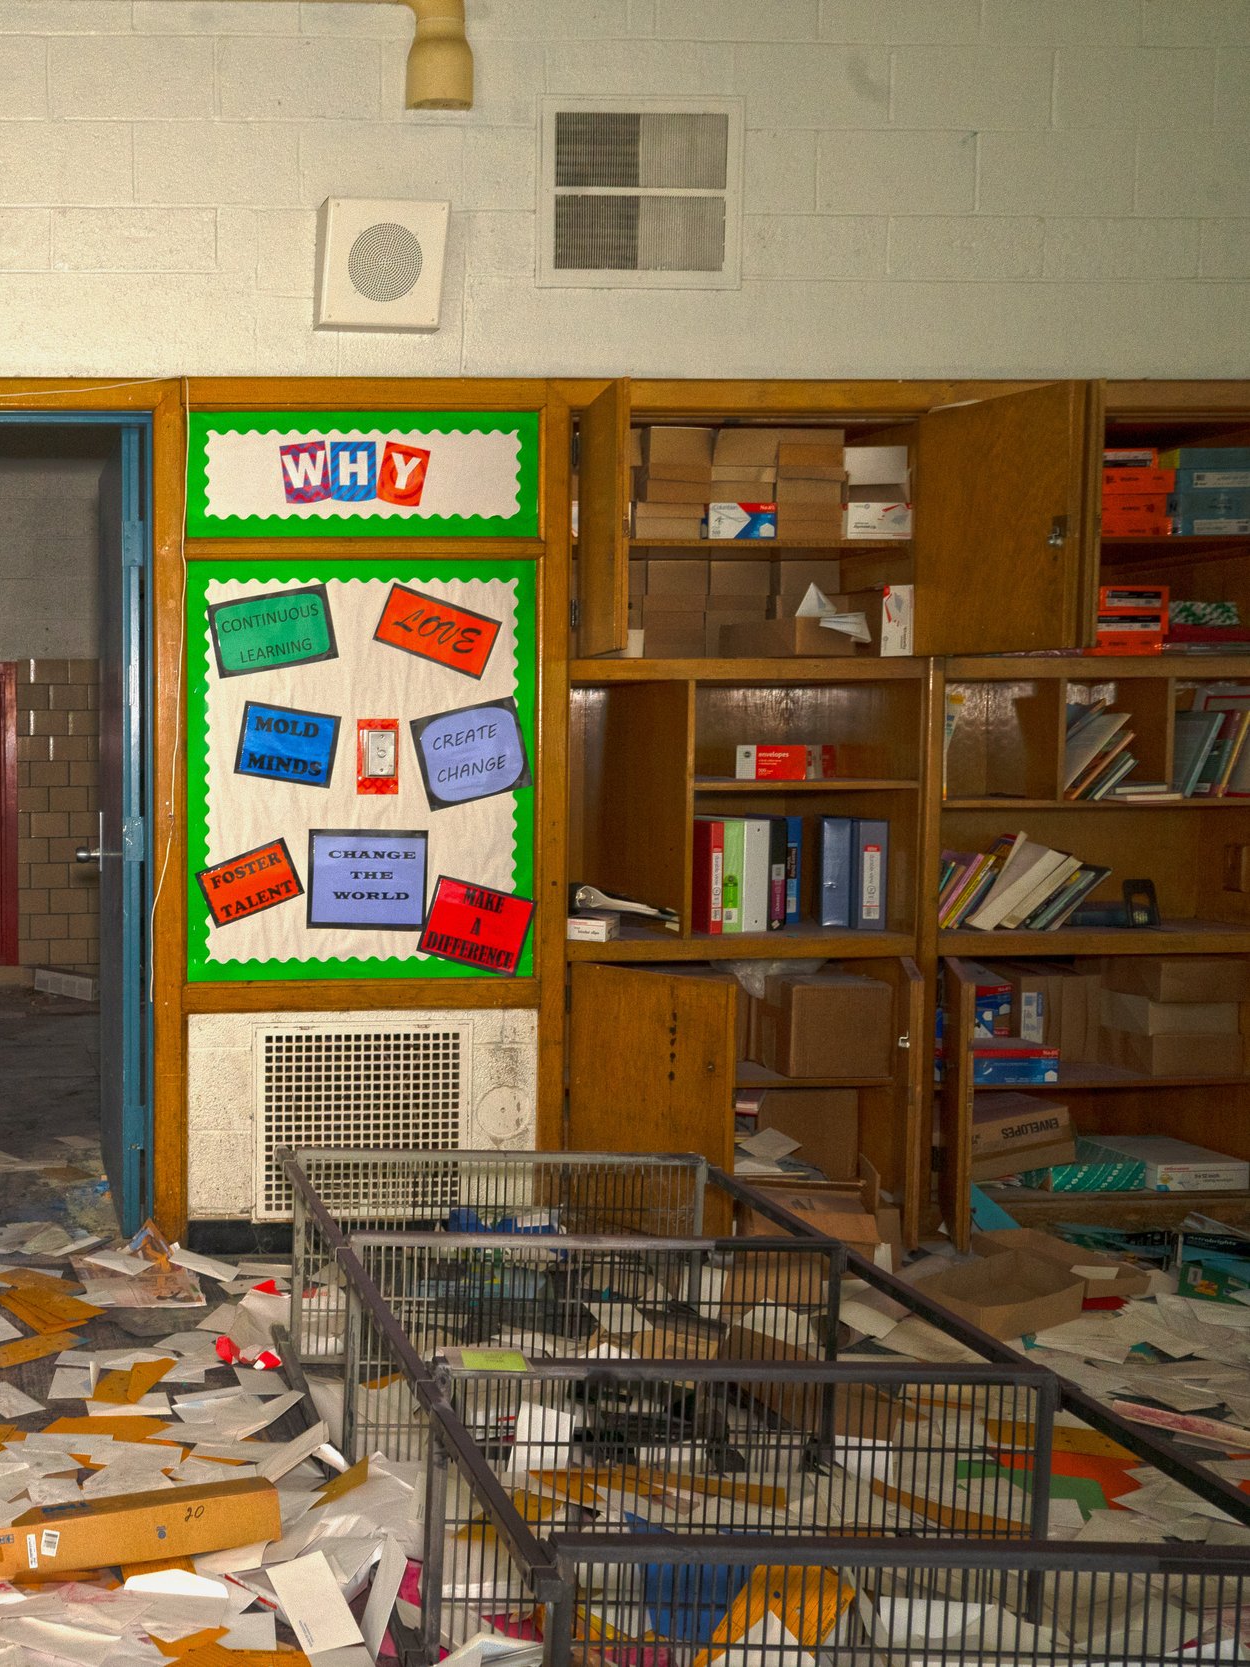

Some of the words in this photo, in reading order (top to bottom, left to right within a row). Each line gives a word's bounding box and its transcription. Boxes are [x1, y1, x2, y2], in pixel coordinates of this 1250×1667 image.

[281, 450, 422, 490] WHY
[221, 603, 319, 633] CONTINUOUS
[392, 609, 482, 654] LOVE
[240, 637, 313, 663] LEARNING
[255, 716, 319, 738] MOLD
[433, 723, 498, 750] CREATE
[247, 752, 322, 777] MINDS
[437, 754, 507, 783] CHANGE
[328, 850, 416, 860] CHANGE
[211, 852, 282, 889] FOSTER
[350, 871, 393, 880] THE
[220, 880, 292, 918] TALENT
[333, 891, 410, 901] WORLD
[463, 887, 504, 914] MAKE
[470, 918, 480, 936] A
[425, 932, 513, 969] DIFFERENCE
[1001, 1118, 1060, 1140] ENVELOPES
[1187, 1234, 1237, 1246] Astrobrights
[184, 1505, 204, 1522] 20
